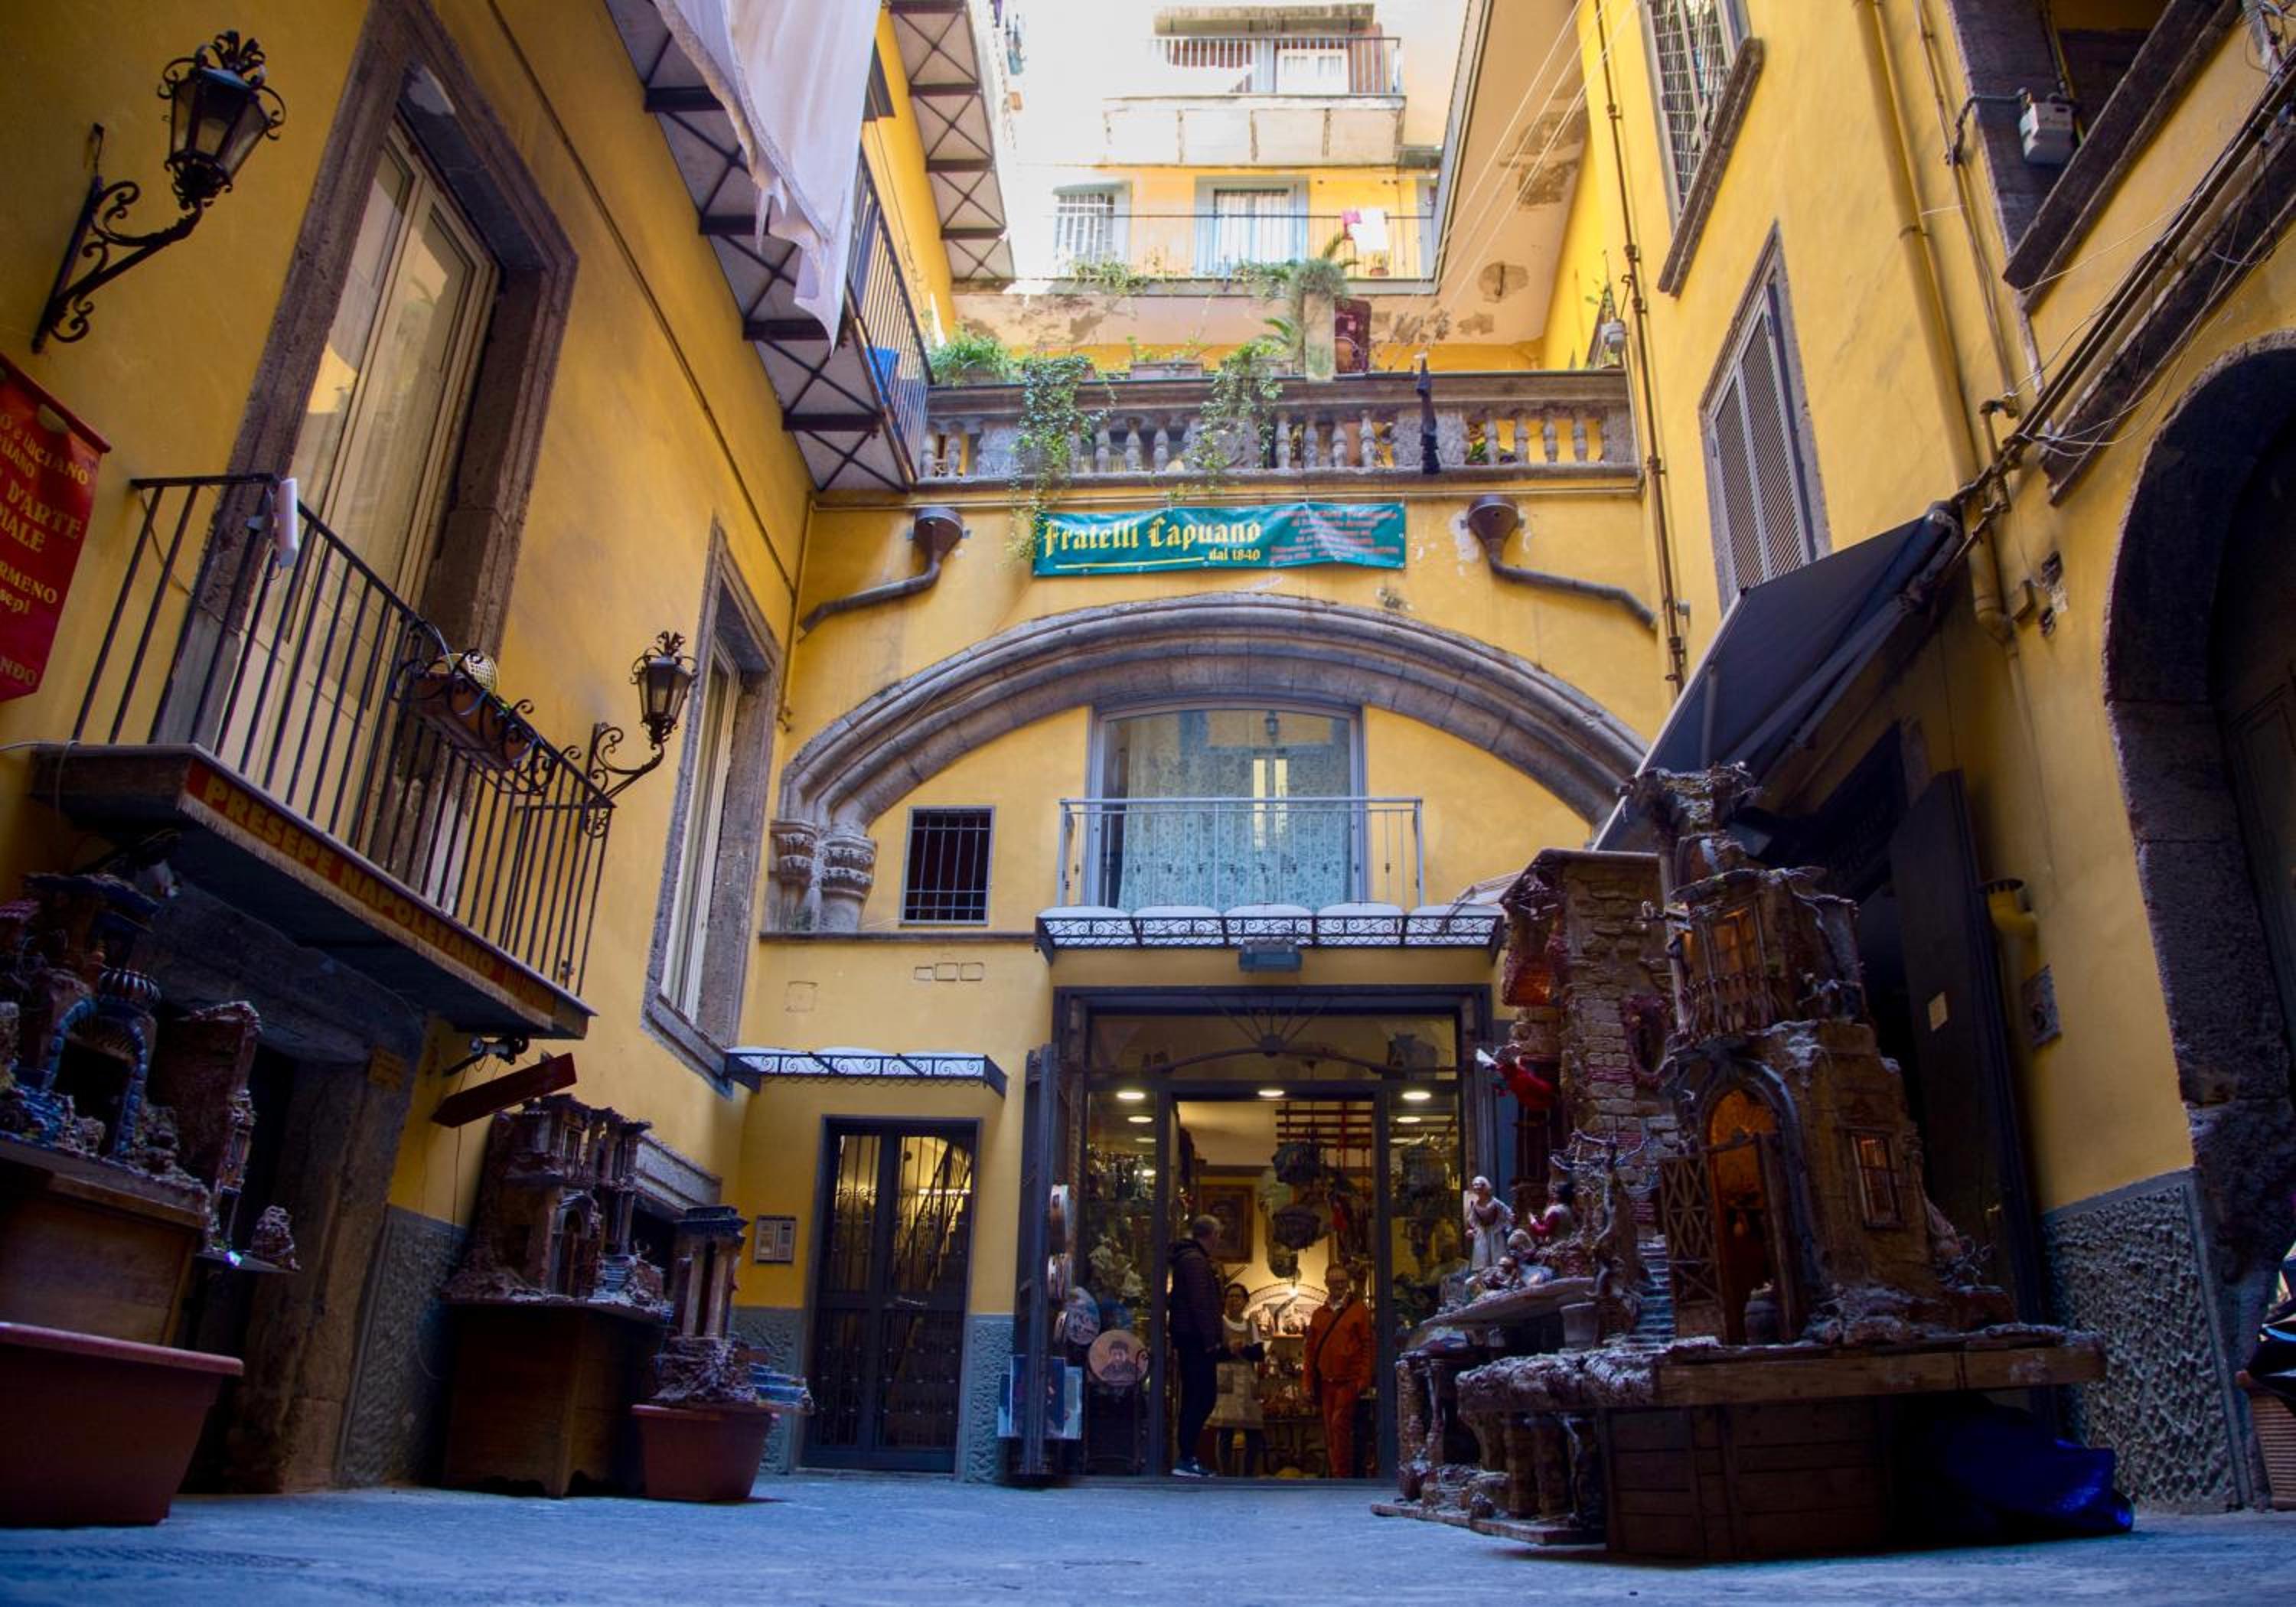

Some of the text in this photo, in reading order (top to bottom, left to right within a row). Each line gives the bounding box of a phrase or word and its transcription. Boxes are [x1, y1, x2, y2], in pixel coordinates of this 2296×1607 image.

[23, 431, 88, 485] LUCIANO
[0, 501, 46, 553] IALE
[6, 478, 82, 540] D'ARTE
[1044, 517, 1262, 558] Fratelli Capuano
[1208, 547, 1228, 561] dal
[1232, 548, 1261, 561] 1840
[204, 768, 497, 978] PRESEPE NAPOLETANO
